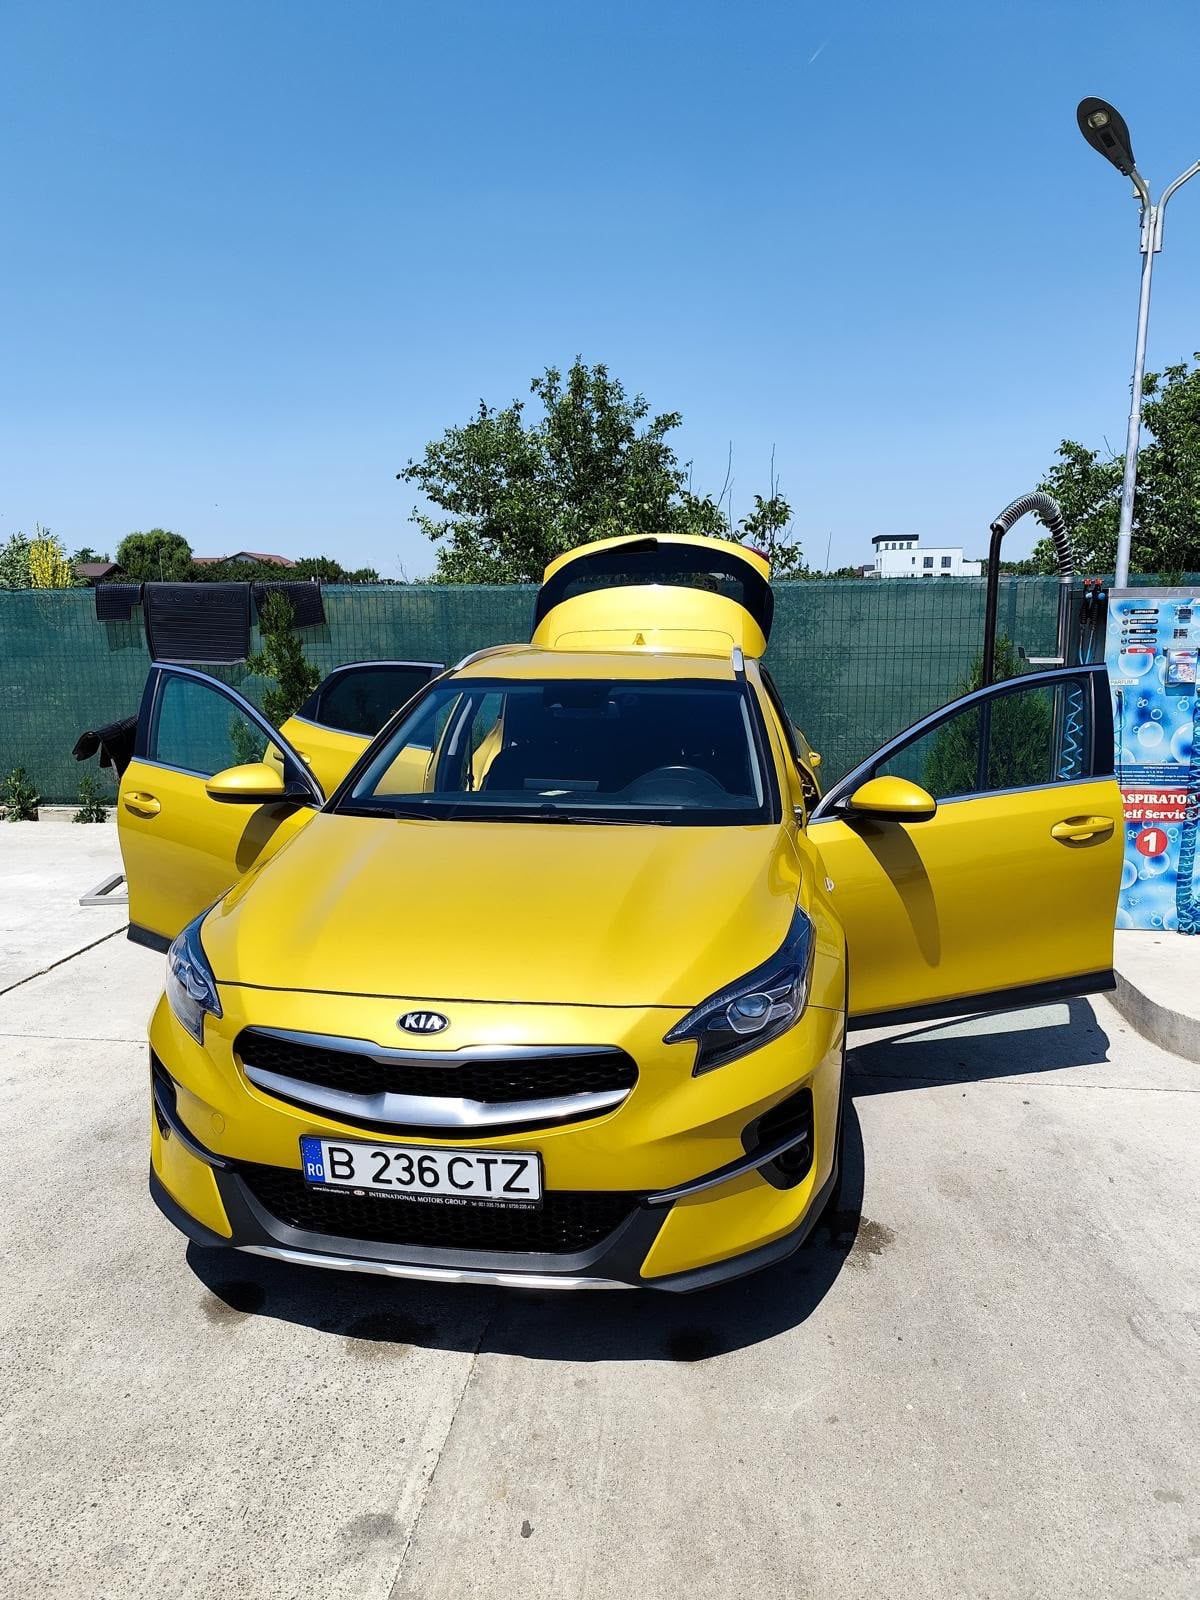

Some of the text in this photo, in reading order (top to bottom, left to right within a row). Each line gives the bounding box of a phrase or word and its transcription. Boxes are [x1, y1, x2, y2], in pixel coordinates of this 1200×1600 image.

[1143, 832, 1157, 853] 1
[405, 1014, 444, 1030] KIA
[308, 1163, 323, 1176] RO
[328, 1147, 530, 1193] B 236 CTZ
[369, 1192, 416, 1202] INTERNATIONAL
[417, 1196, 443, 1204] MOTORS
[445, 1198, 467, 1206] GROUP
